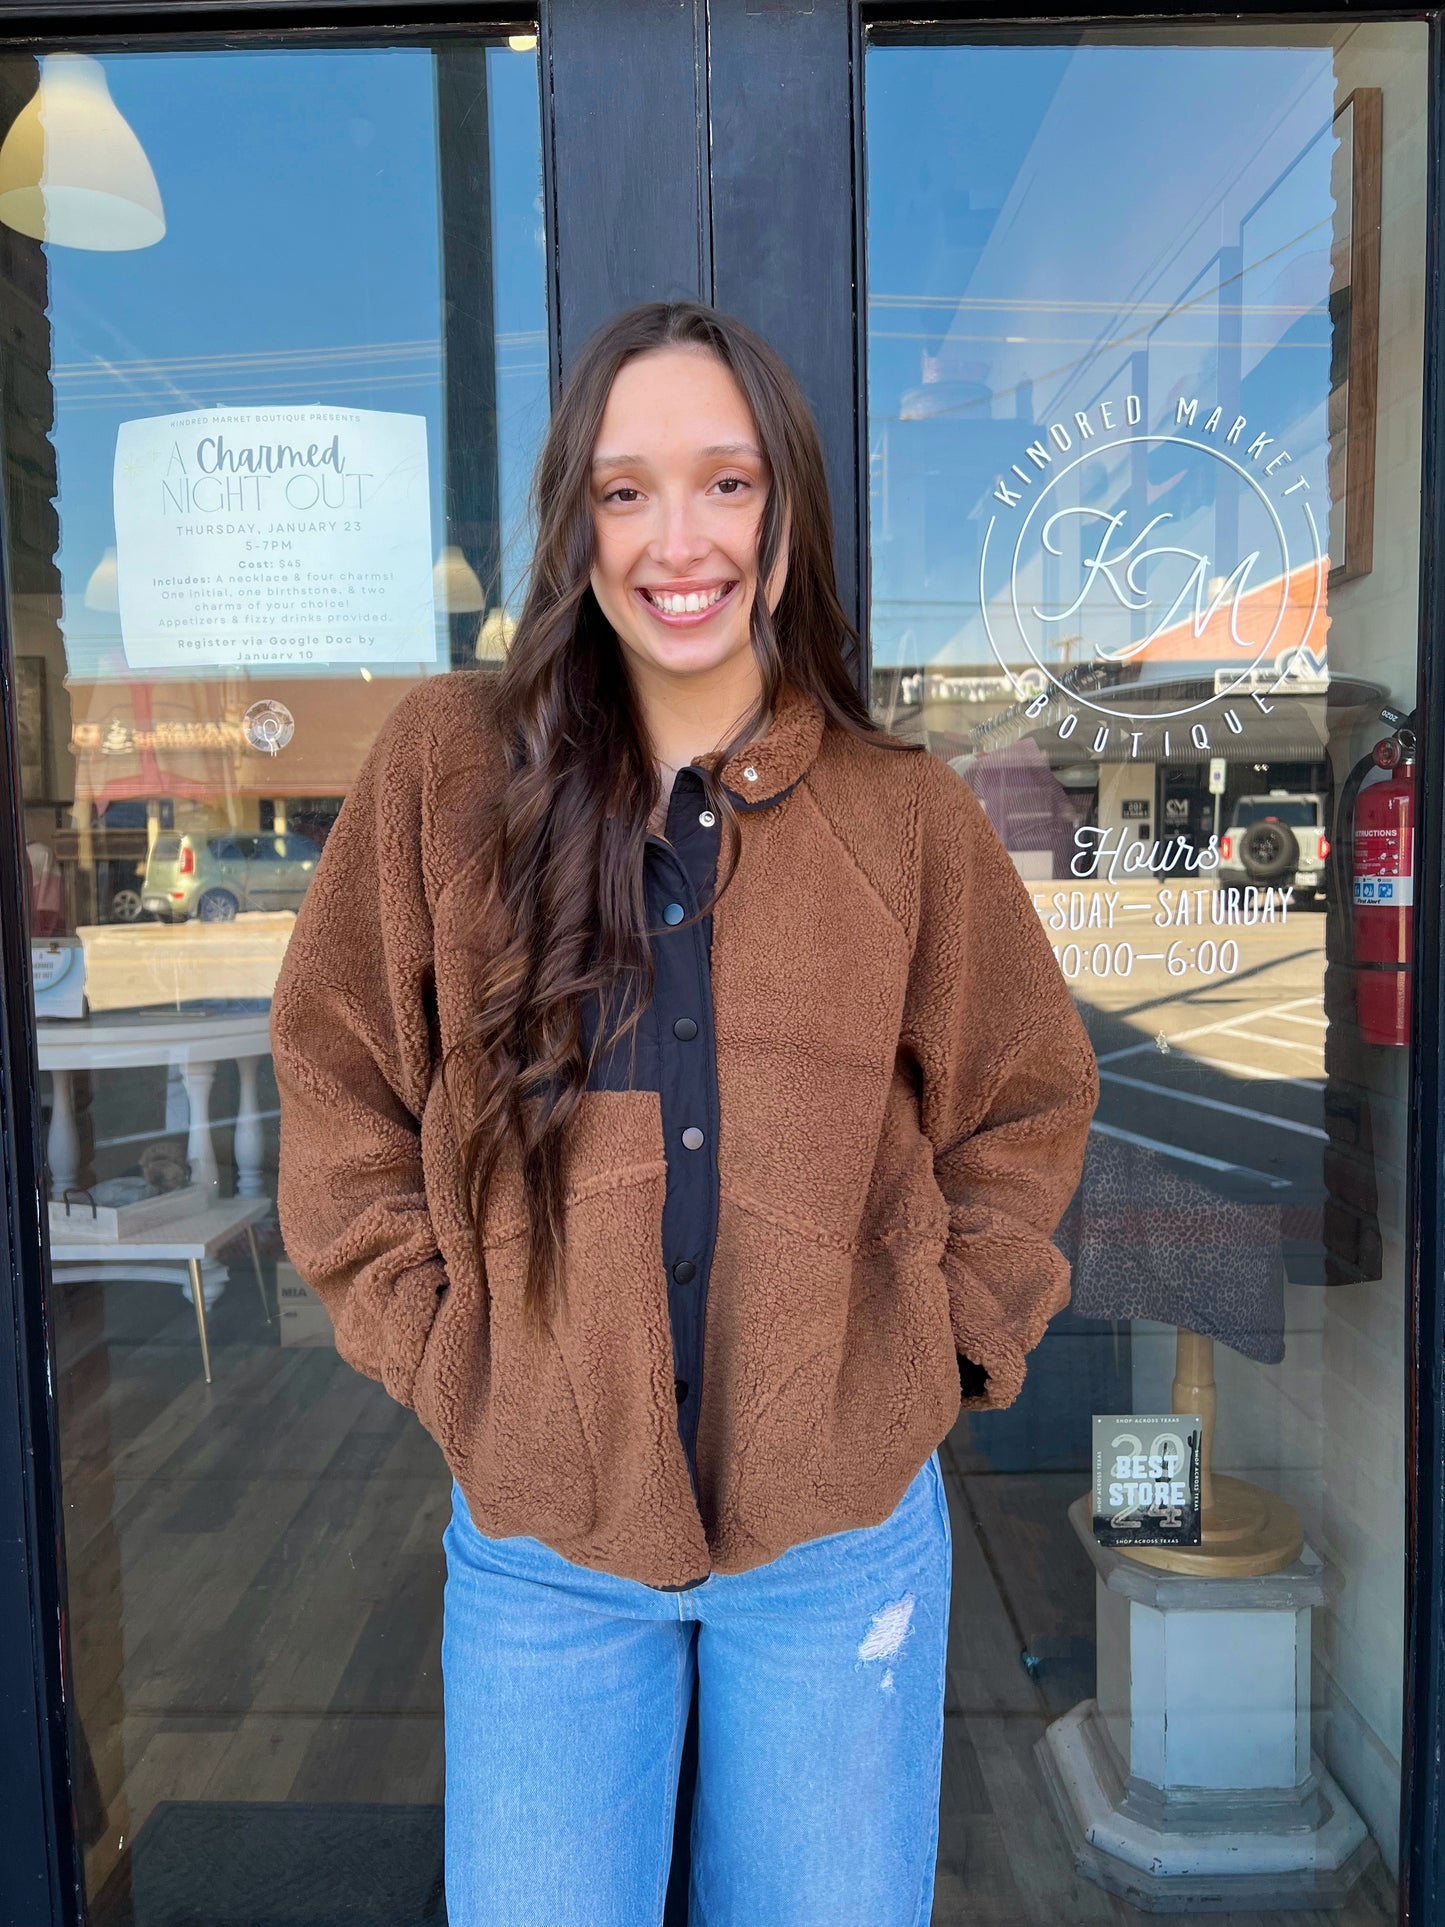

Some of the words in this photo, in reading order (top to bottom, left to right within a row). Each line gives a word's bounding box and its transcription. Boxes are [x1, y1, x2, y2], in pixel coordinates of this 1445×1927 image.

[170, 416, 209, 428] KINDRED
[212, 415, 251, 424] MARKET
[255, 413, 306, 423] BOUTIQUE
[310, 413, 361, 423] PRESENTS
[167, 440, 188, 477] A
[196, 434, 346, 475] Charmed
[993, 394, 1142, 508] KINDRED
[1176, 396, 1310, 497] MARKET
[161, 474, 272, 516] NIGHT
[285, 472, 374, 511] OUT
[176, 522, 262, 537] THURSDAY,
[267, 521, 337, 534] JANUARY
[343, 520, 362, 532] 23
[245, 540, 293, 552] 5-7PM
[238, 560, 274, 570] Cost:
[278, 558, 302, 569] $45
[152, 575, 212, 587] Includes:
[215, 575, 224, 584] A
[228, 573, 289, 584] necklace
[294, 572, 301, 582] &
[306, 572, 334, 582] four
[339, 571, 394, 582] charms!
[161, 590, 185, 600] One
[189, 588, 233, 598] initial,
[238, 588, 261, 597] one
[266, 586, 343, 596] birthstone,
[347, 585, 355, 595] &
[361, 585, 386, 595] two
[194, 602, 242, 612] charms
[247, 601, 260, 610] of
[265, 602, 295, 612] your
[300, 599, 350, 609] choice!
[158, 615, 226, 628] Appetizers
[231, 614, 239, 624] &
[244, 613, 275, 625] fizzy
[281, 613, 322, 624] drinks
[327, 611, 392, 624] provided.
[178, 637, 237, 649] Register
[242, 636, 263, 647] via
[269, 635, 319, 649] Google
[325, 634, 352, 645] Doc
[359, 634, 376, 646] by
[298, 650, 314, 660] 10
[1023, 688, 1275, 758] BOUTIQUE
[1070, 826, 1220, 886] Hours
[1116, 1455, 1179, 1479] BEST
[1108, 1481, 1186, 1506] STORE
